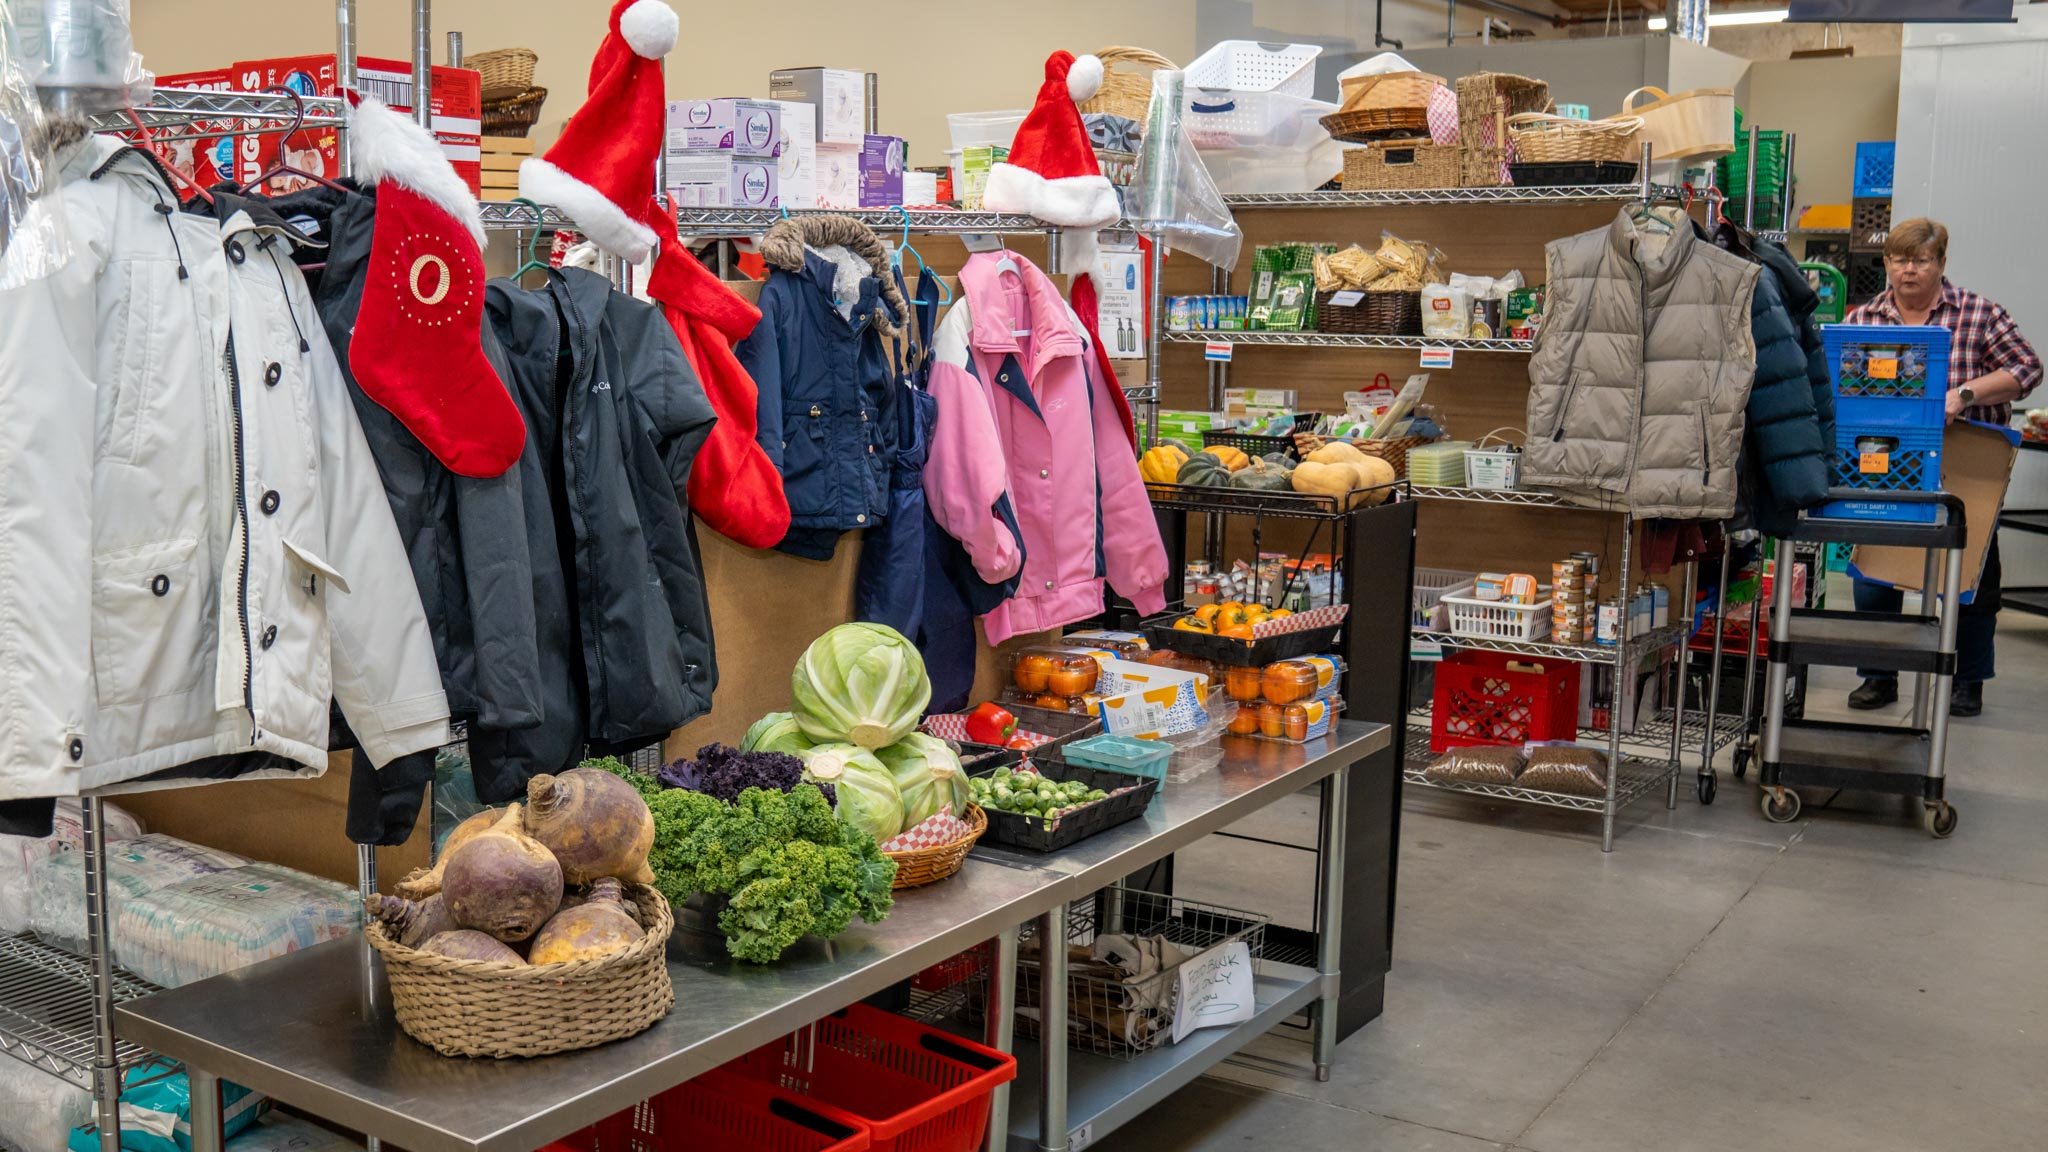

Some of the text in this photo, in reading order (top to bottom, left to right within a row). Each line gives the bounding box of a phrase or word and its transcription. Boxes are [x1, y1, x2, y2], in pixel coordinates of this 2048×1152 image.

[750, 123, 768, 133] Similac
[747, 178, 765, 188] Similac
[409, 254, 451, 305] O
